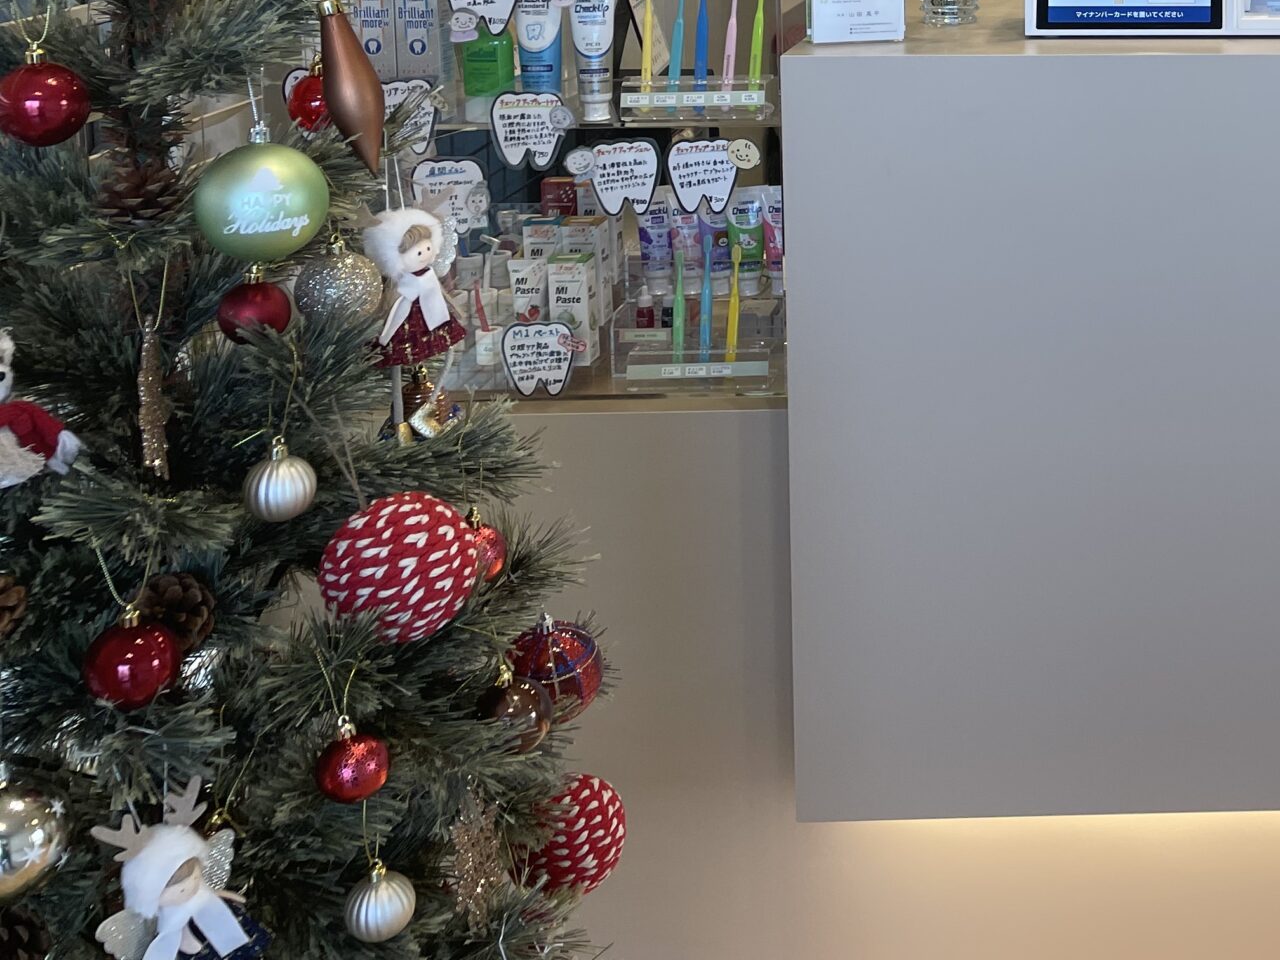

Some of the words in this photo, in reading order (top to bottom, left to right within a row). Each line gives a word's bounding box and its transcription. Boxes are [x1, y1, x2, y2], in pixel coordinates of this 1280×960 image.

[353, 6, 389, 18] Brilliant
[398, 7, 434, 19] Brilliant
[575, 4, 609, 18] Check-Up
[362, 20, 383, 28] more
[407, 20, 427, 29] more
[224, 207, 310, 236] Holidays
[515, 277, 528, 285] MI
[515, 287, 540, 295] Paste
[555, 287, 568, 295] MI
[555, 296, 581, 304] Paste
